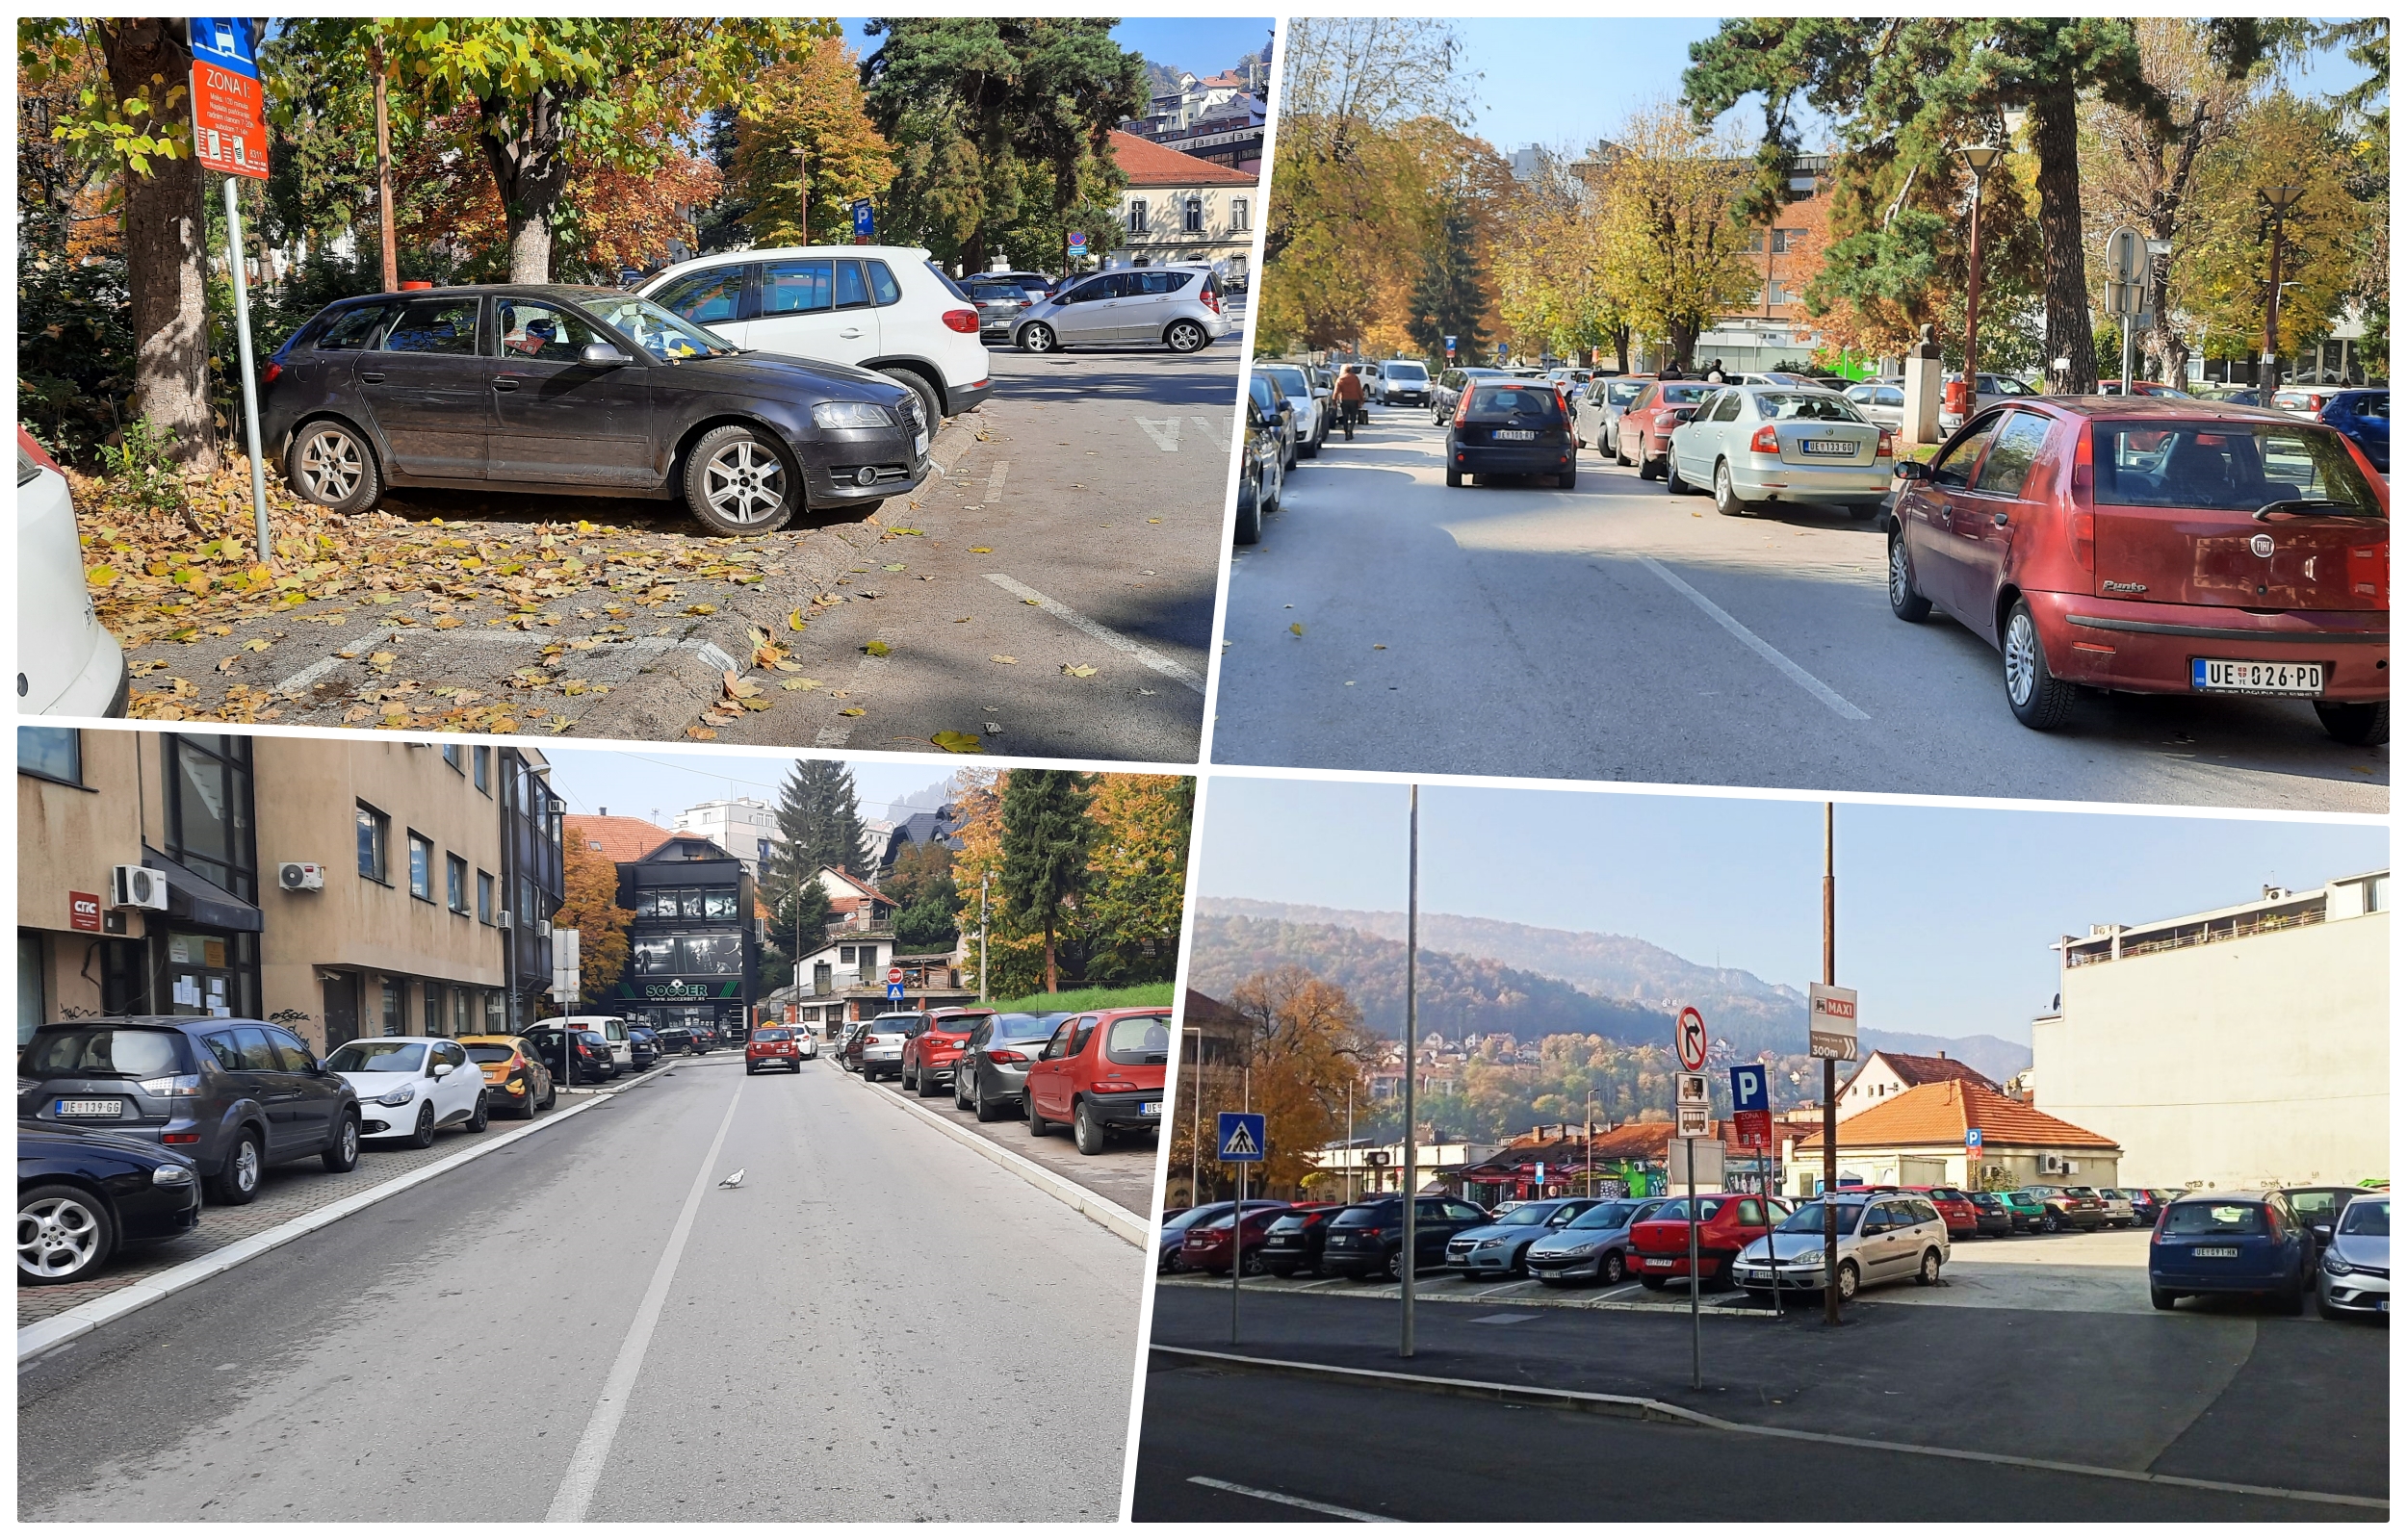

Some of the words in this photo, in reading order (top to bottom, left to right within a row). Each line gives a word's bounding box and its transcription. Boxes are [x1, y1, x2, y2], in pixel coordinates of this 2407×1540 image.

[206, 68, 242, 96] ZONA
[858, 209, 868, 223] P
[2256, 540, 2270, 552] FIAT
[2103, 579, 2147, 592] Punto
[2210, 663, 2234, 684] UE
[645, 984, 709, 997] SOCCER
[1828, 1002, 1852, 1016] MAXI
[1812, 1044, 1838, 1058] 300m
[1738, 1071, 1758, 1105] P
[64, 1102, 75, 1112] UE
[1969, 1131, 1978, 1144] P
